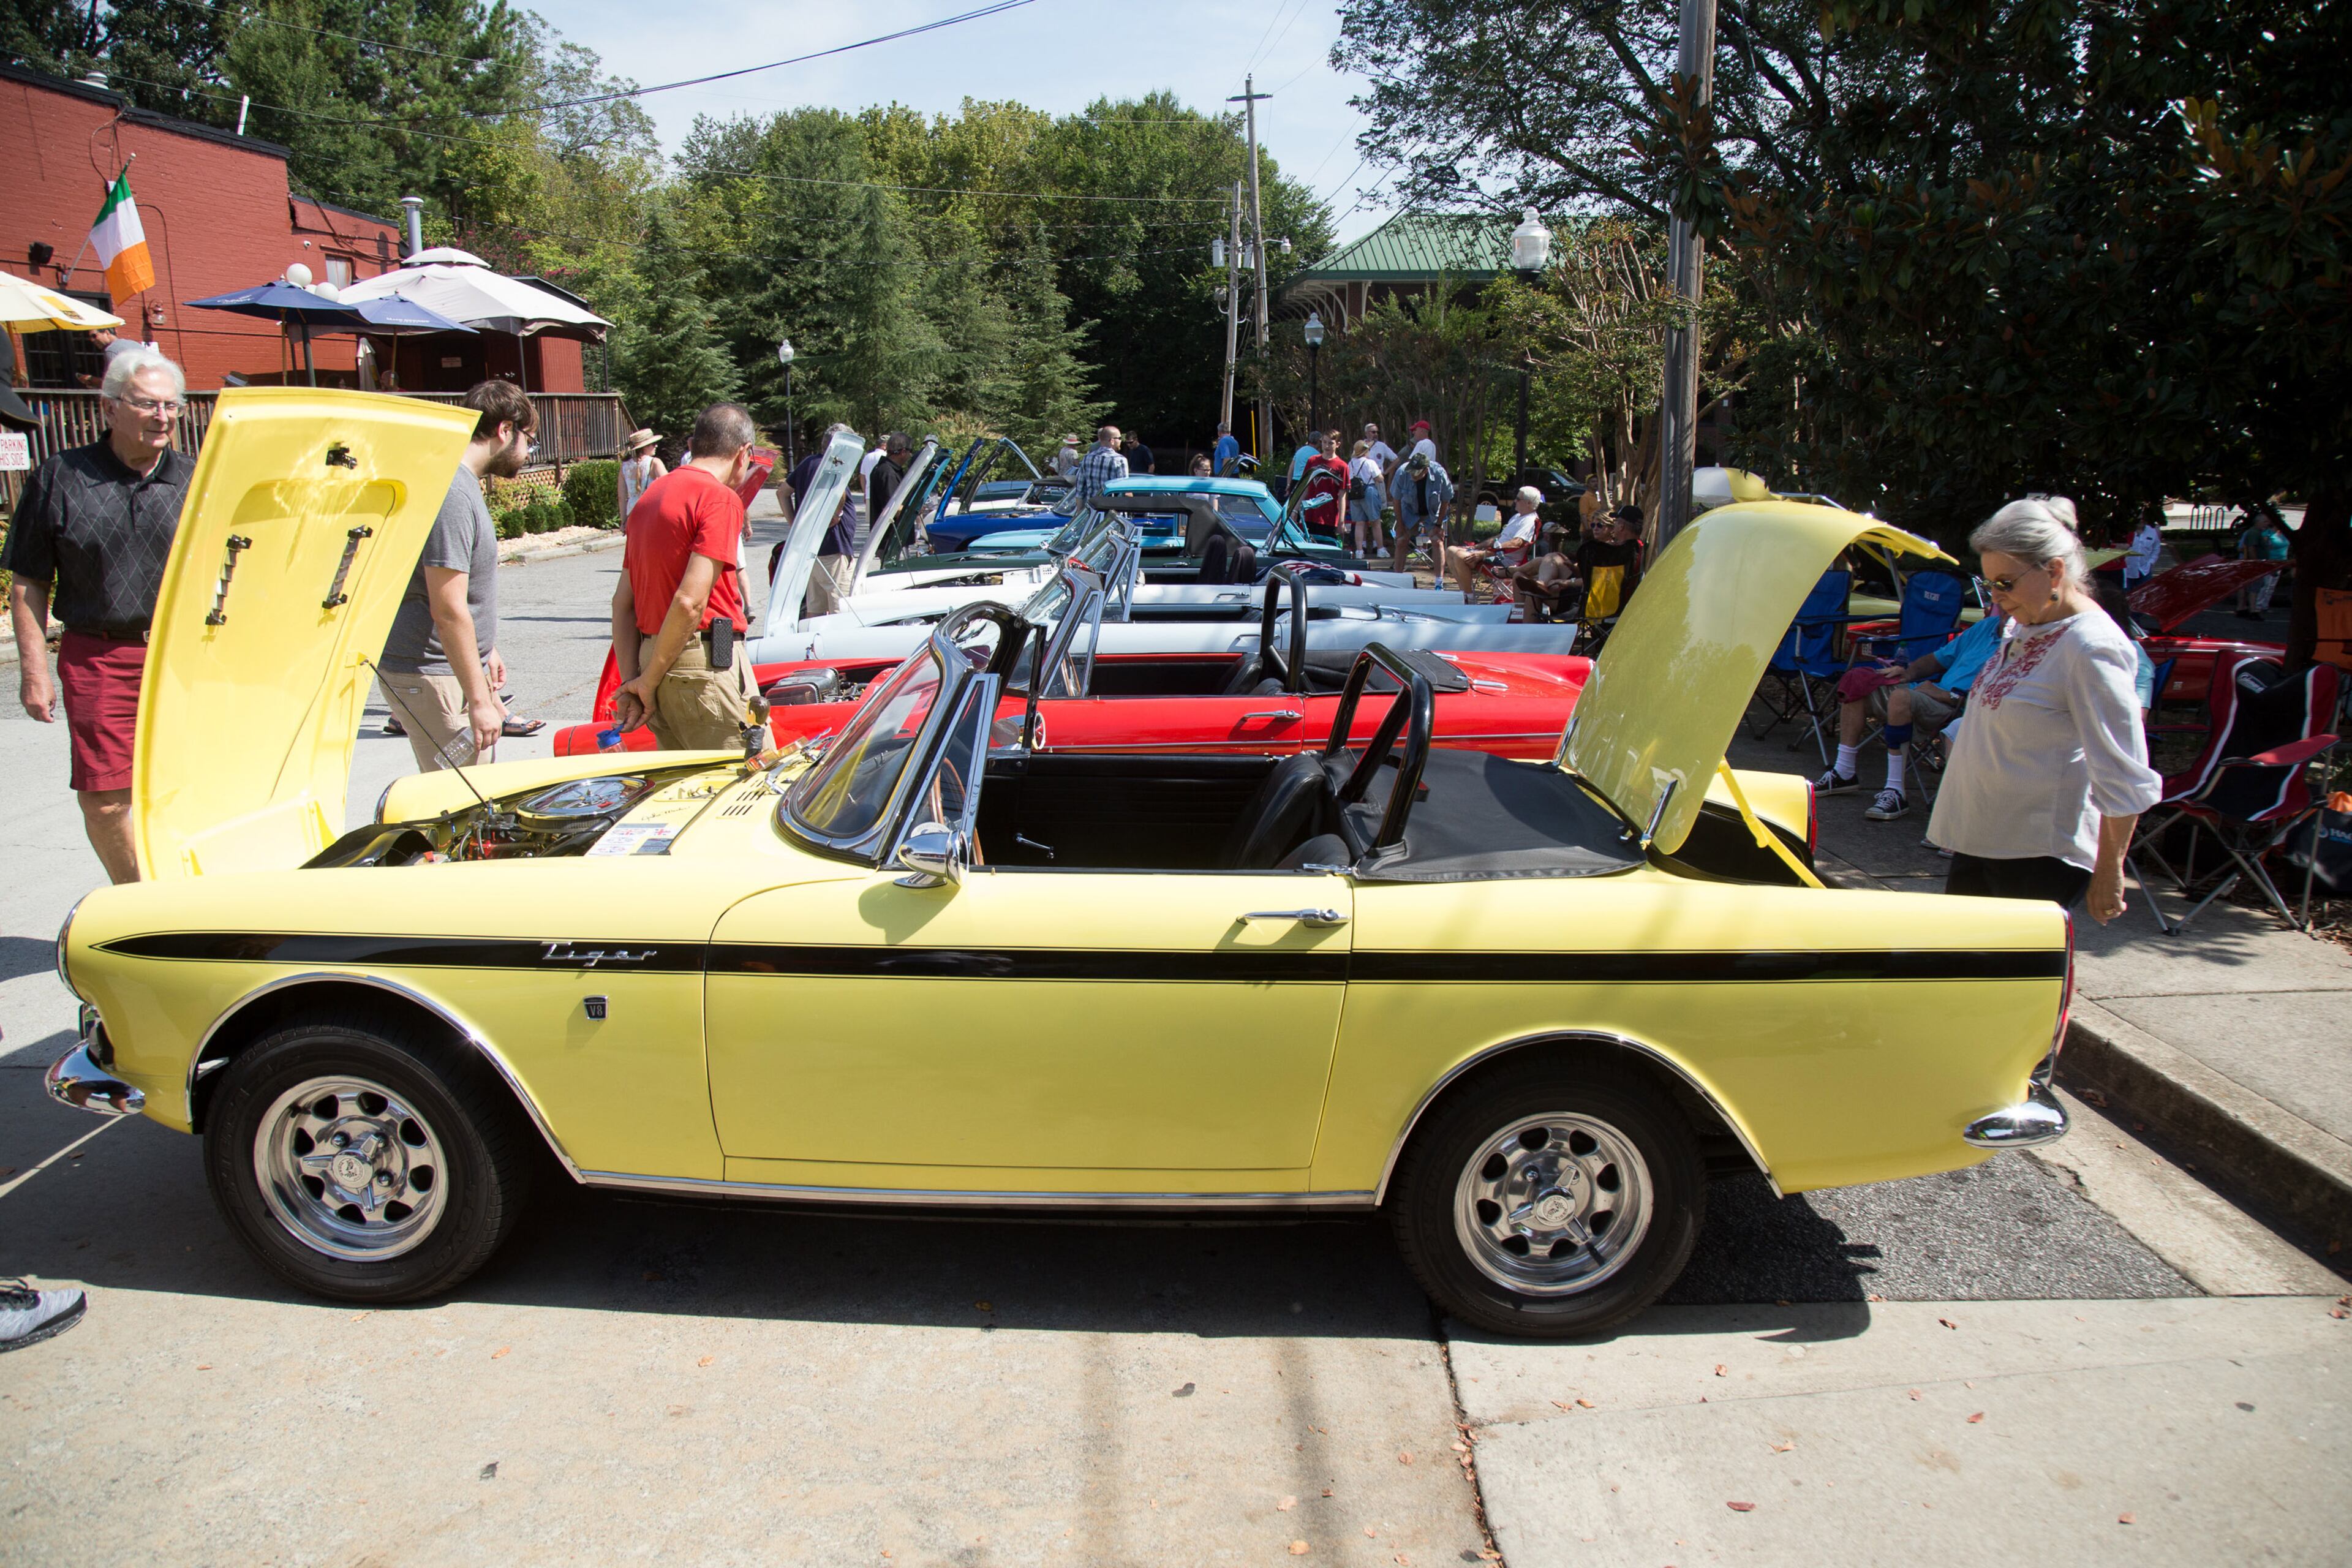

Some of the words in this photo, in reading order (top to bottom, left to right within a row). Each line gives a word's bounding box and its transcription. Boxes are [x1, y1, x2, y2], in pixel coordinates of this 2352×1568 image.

[1, 439, 27, 451] PARKING
[0, 453, 10, 466] HIS
[11, 453, 25, 466] SIDE
[540, 941, 657, 967] Tiger
[589, 1005, 603, 1016] V8
